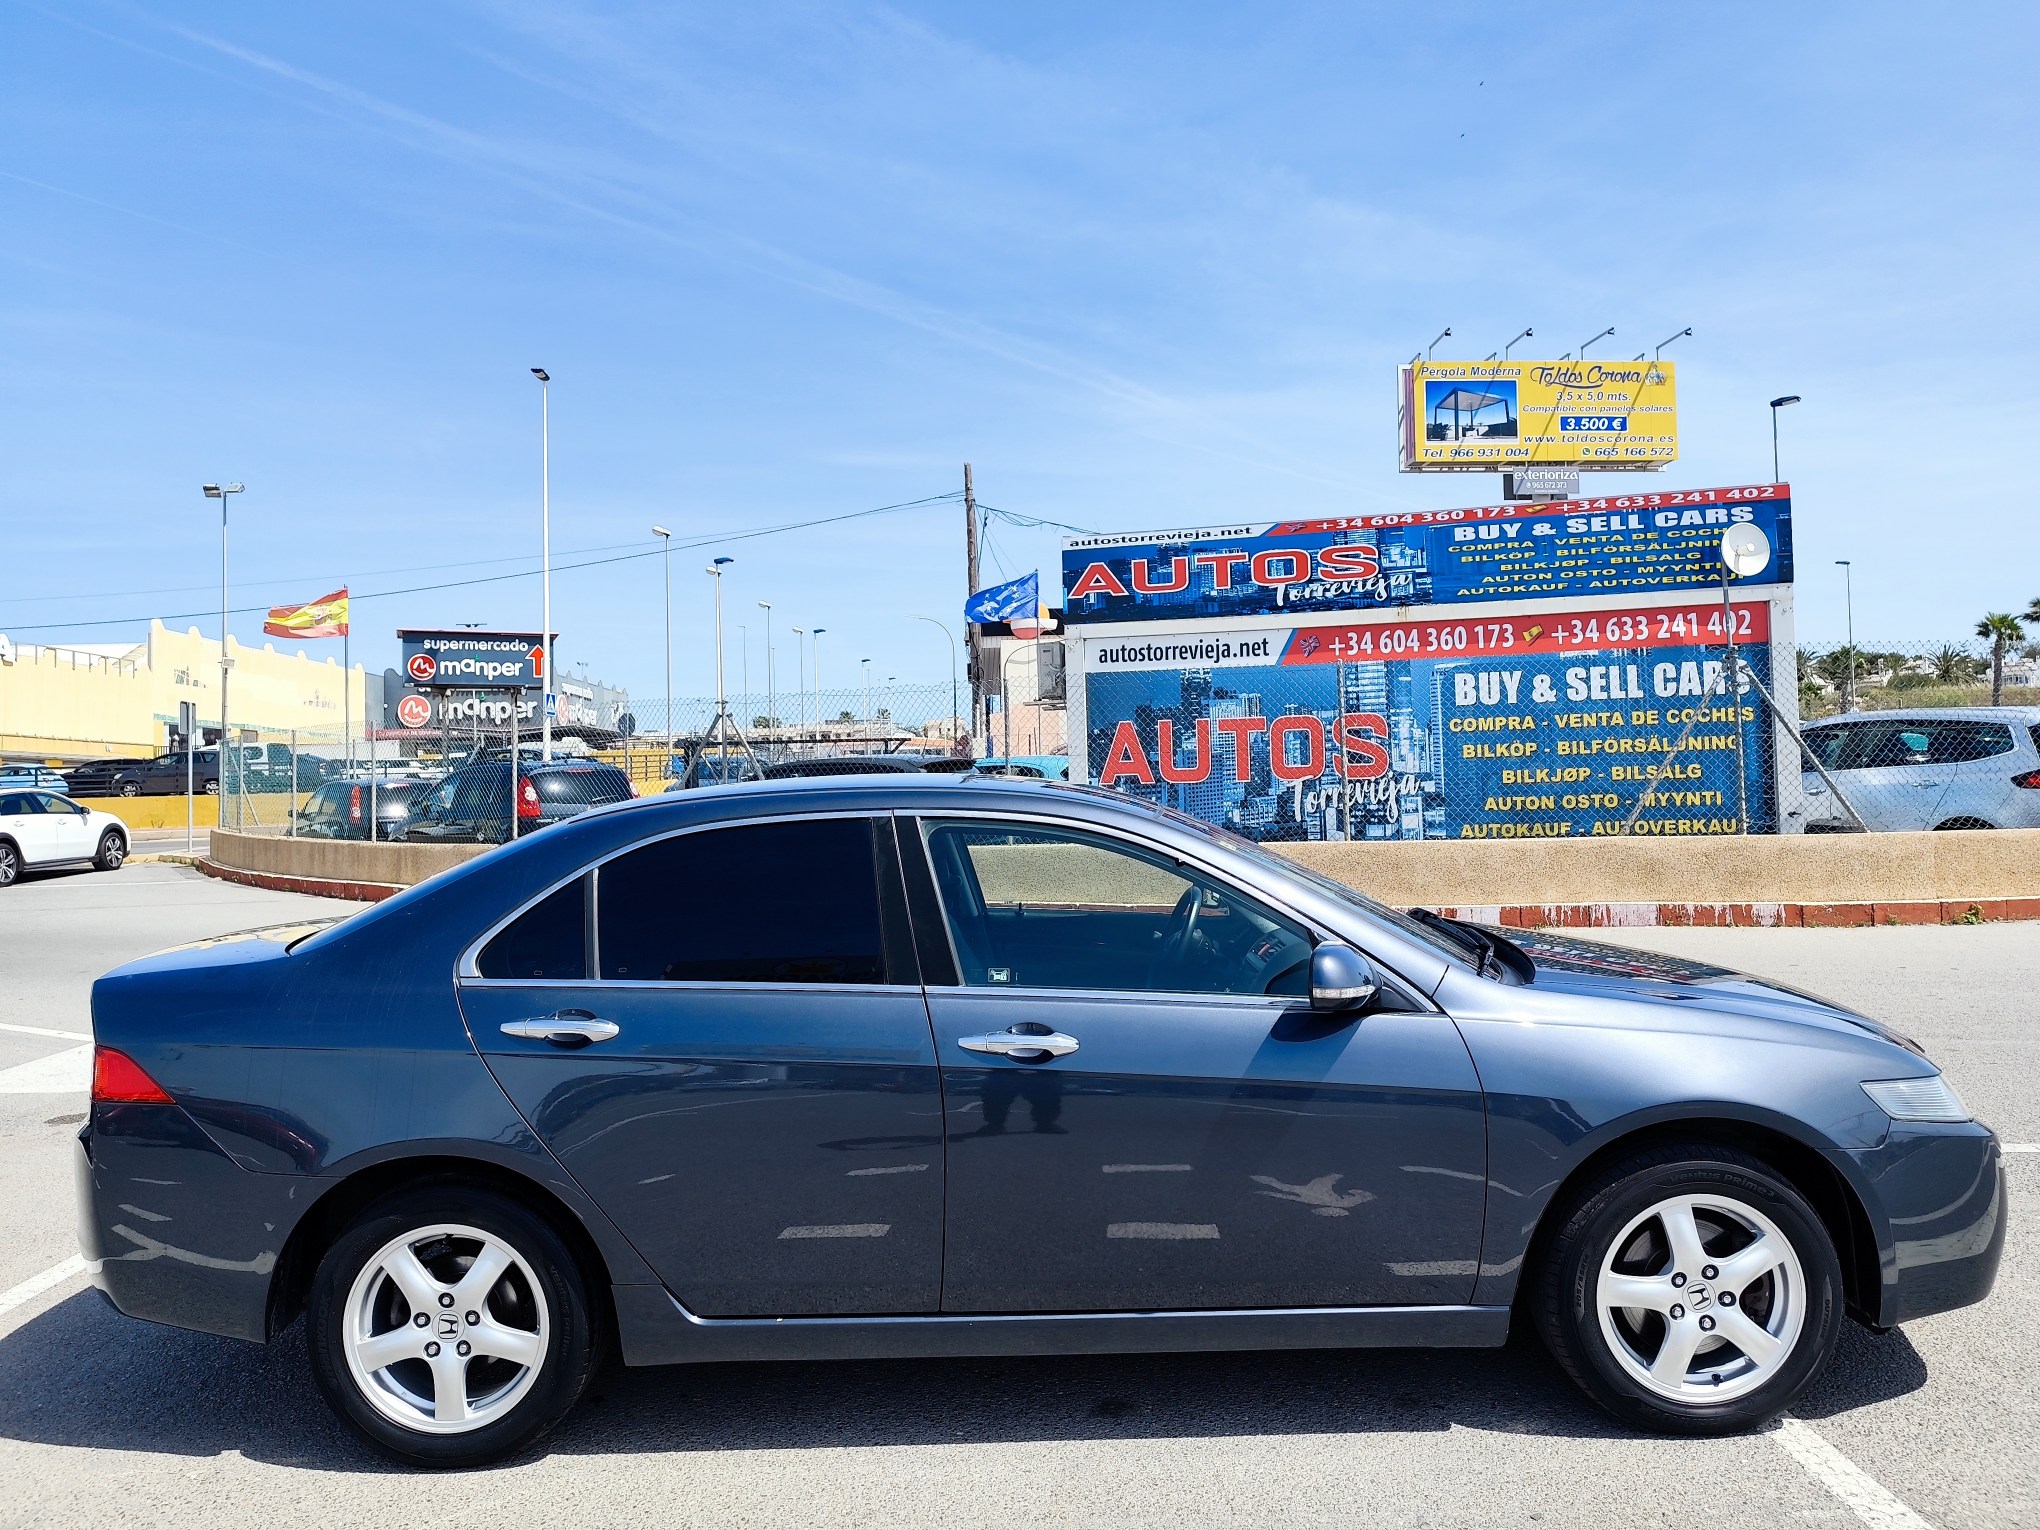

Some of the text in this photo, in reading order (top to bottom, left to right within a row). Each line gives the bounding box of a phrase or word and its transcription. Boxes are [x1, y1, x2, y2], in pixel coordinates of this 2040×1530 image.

[1470, 366, 1521, 376] Moderna
[1530, 366, 1642, 388] Toldos Corona
[1556, 391, 1632, 402] 3,5 x 5,0 mts.
[1522, 404, 1577, 413] Compatible
[1580, 405, 1597, 413] con
[1639, 404, 1674, 413] solares
[1566, 418, 1623, 430] 3.500 €
[1524, 434, 1674, 443] www.toldoscorona.es
[1423, 447, 1529, 458] Tel. 966 931 004
[1595, 447, 1674, 457] 665 166 572
[1514, 469, 1579, 480] exterioriza
[1556, 481, 1567, 489] 373
[1556, 486, 1775, 513] +34 633 241 402
[1316, 506, 1516, 530] +34 604 360 173
[1454, 506, 1754, 542] BUY & SELL CARS
[1069, 525, 1253, 548] autostorrevieja.net
[1448, 541, 1535, 553] COMPRA
[1554, 534, 1625, 546] VENTA
[1632, 531, 1659, 541] DE
[1667, 527, 1728, 539] COCH
[1461, 551, 1536, 564] BILKÖP
[1500, 559, 1590, 572] BILKJØP
[1610, 551, 1701, 565] BILSALG
[1067, 543, 1380, 600] AUTOS
[1482, 572, 1553, 584] AUTON
[1560, 568, 1617, 579] OSTO
[1637, 562, 1722, 574] MYYNTI
[1269, 573, 1412, 607] Torrevieja
[1457, 582, 1569, 597] AUTOKAUF
[1551, 609, 1752, 645] +34 633 241 402
[423, 639, 529, 652] supermercado
[1098, 637, 1270, 664] autostorrevieja.net
[1329, 623, 1514, 656] +34 604 360 173
[440, 658, 523, 681] manper
[1454, 670, 1522, 706] BUY
[1531, 674, 1557, 703] &
[1565, 664, 1644, 702] SELL
[439, 699, 537, 725] manper
[1449, 715, 1536, 733] COMPRA
[1554, 711, 1625, 729] VENTA
[1631, 709, 1660, 726] DE
[1666, 706, 1755, 725] COCHES
[1099, 712, 1390, 786] AUTOS
[1462, 739, 1538, 759] BILKÖP
[1502, 767, 1591, 785] BILKJØP
[1611, 763, 1703, 782] BILSALG
[1285, 770, 1422, 823] Torrevieja
[1484, 795, 1555, 811] AUTON
[1562, 793, 1619, 809] OSTO
[1461, 822, 1572, 838] AUTOKAUF
